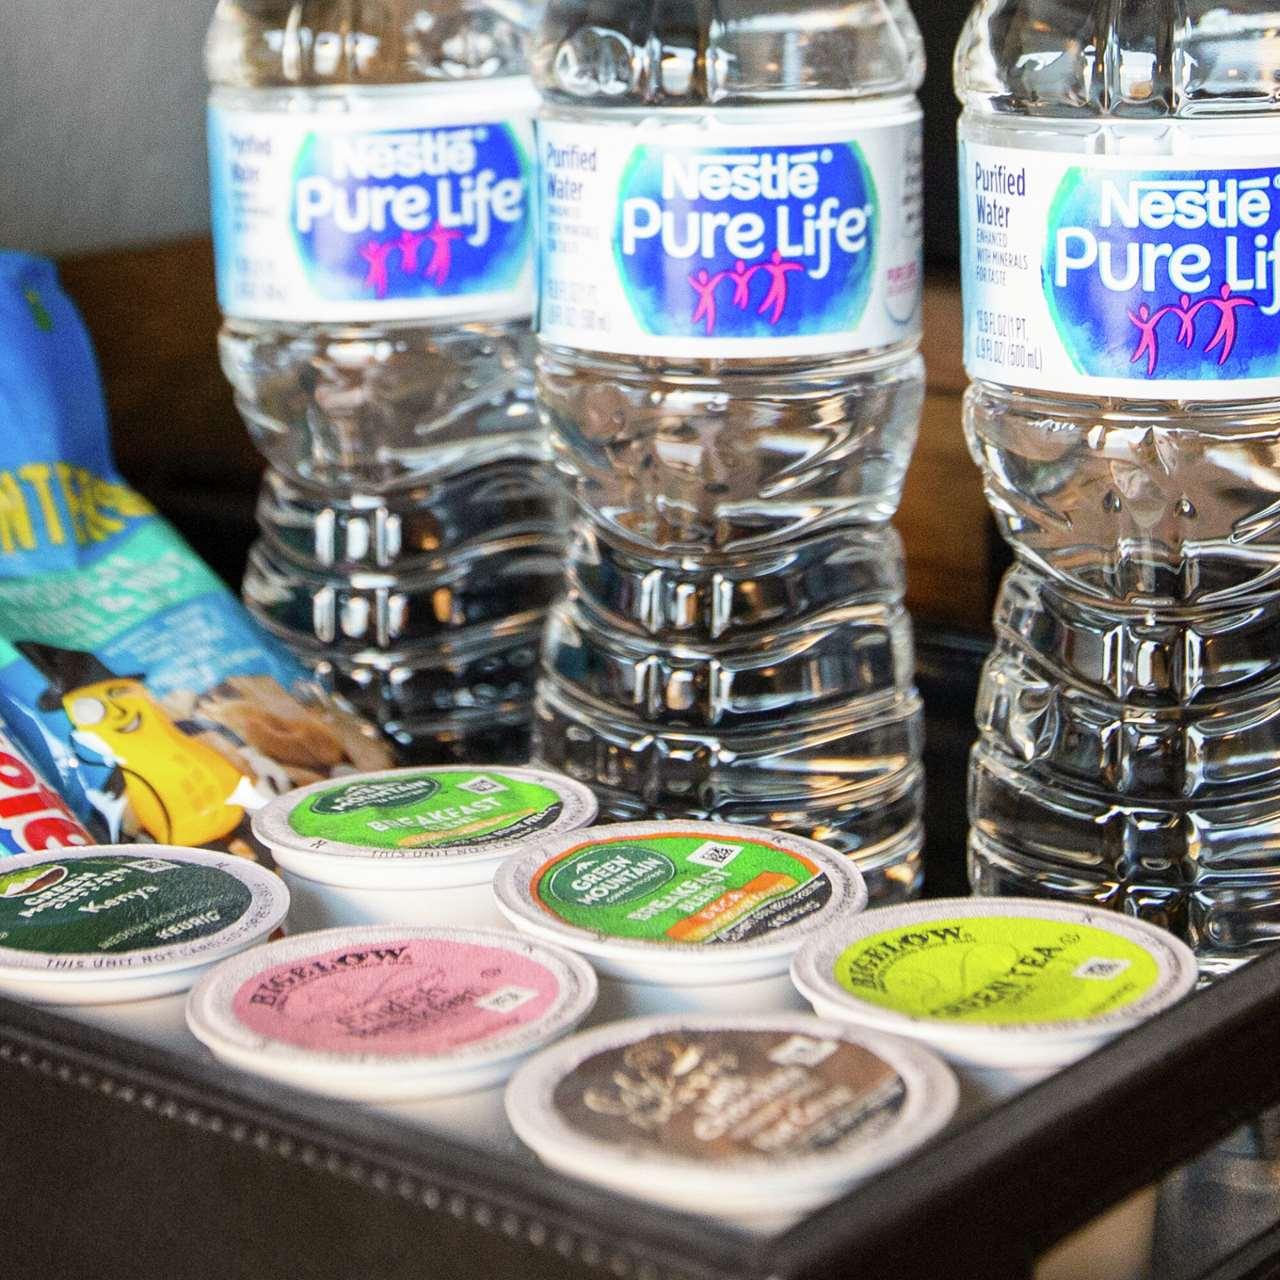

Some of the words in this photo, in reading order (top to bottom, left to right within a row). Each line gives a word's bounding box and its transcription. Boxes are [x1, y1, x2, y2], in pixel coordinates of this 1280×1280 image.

[975, 161, 1026, 197] Purified
[296, 175, 432, 234] Pure
[437, 170, 523, 247] Life
[976, 195, 1010, 228] Water
[622, 199, 766, 260] Pure
[776, 198, 868, 280] Life
[1056, 226, 1211, 292] Pure
[366, 796, 502, 832] BREAKFAST
[18, 867, 133, 918] MOUNTAIN
[23, 871, 98, 906] GREEN
[570, 854, 632, 892] GREEN
[576, 857, 665, 906] MOUNTAIN
[78, 885, 160, 913] Kenya
[626, 869, 733, 922] BREAKFAST
[45, 958, 84, 969] THIS
[93, 956, 133, 968] UNIT
[249, 945, 408, 1007] BIGELOW
[848, 925, 961, 991] BIGELOW
[1004, 946, 1063, 977] TEA
